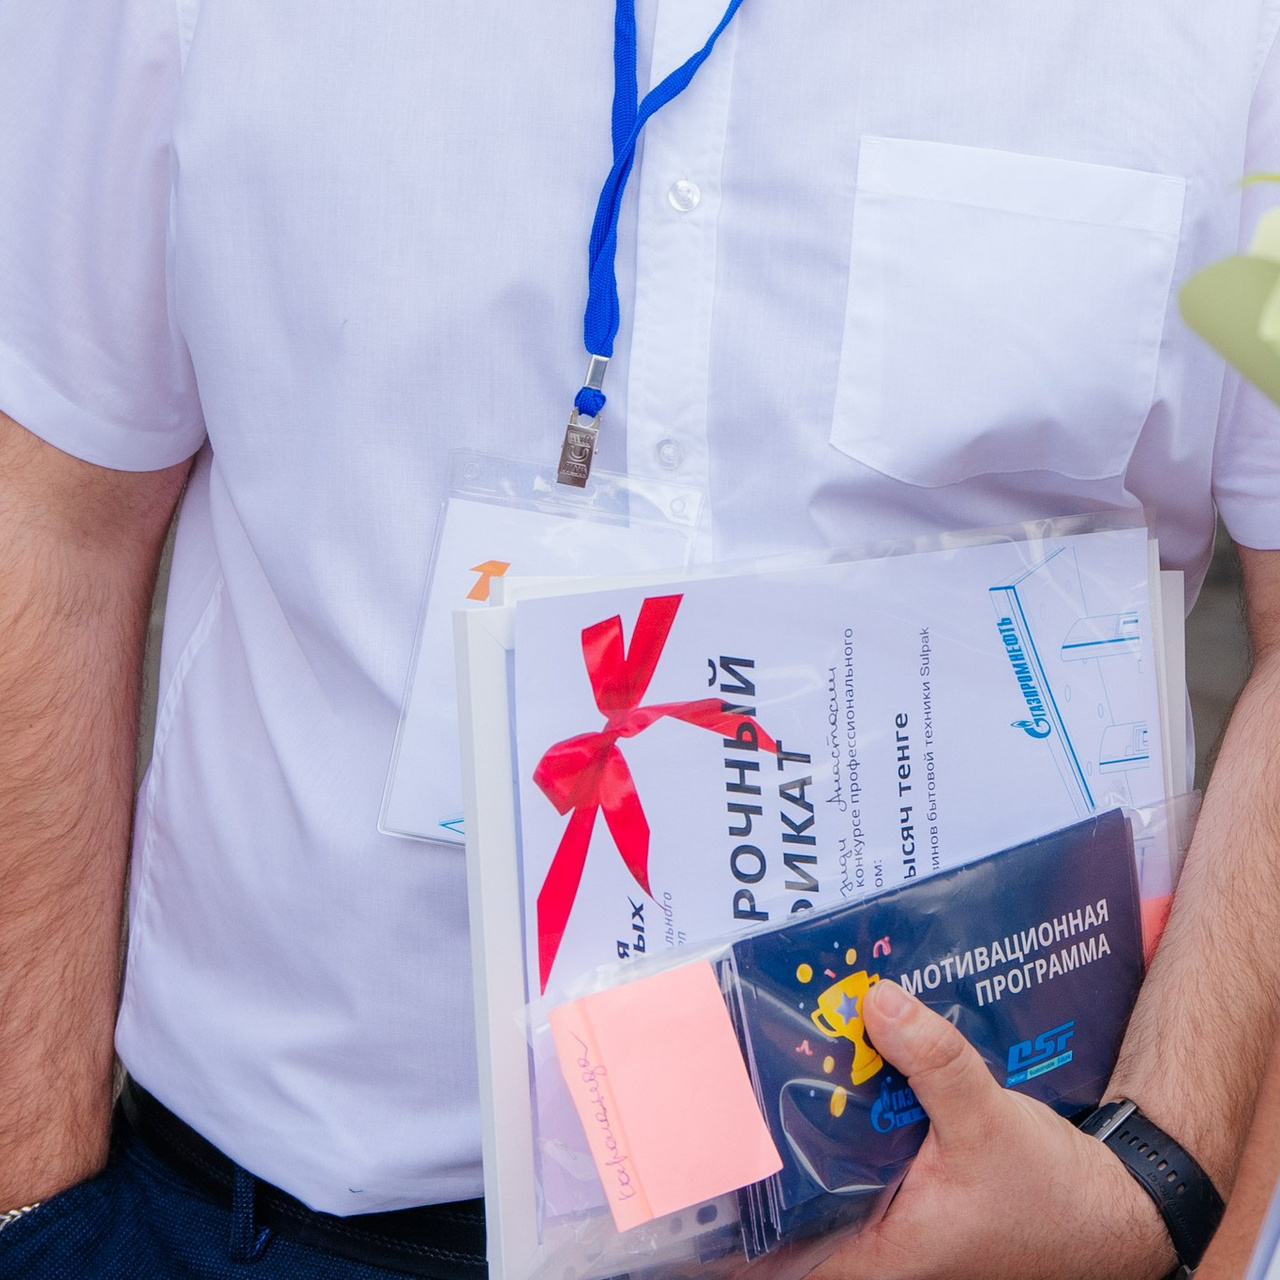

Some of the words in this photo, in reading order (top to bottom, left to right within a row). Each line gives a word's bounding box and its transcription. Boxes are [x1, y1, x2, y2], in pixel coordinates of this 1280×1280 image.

[918, 626, 933, 677] Sulpak
[997, 616, 1046, 720] ГАЗПРОМНЕФТЬ
[842, 628, 861, 804] профессионального
[892, 711, 914, 797] тенге
[919, 681, 934, 748] техники
[707, 655, 770, 922] РОЧНЫЙ
[921, 751, 938, 822] бытовой
[848, 809, 866, 888] конкурсе
[900, 899, 1110, 997] МОТИВАЦИОННАЯ
[975, 933, 1112, 1007] ПРОГРАММА
